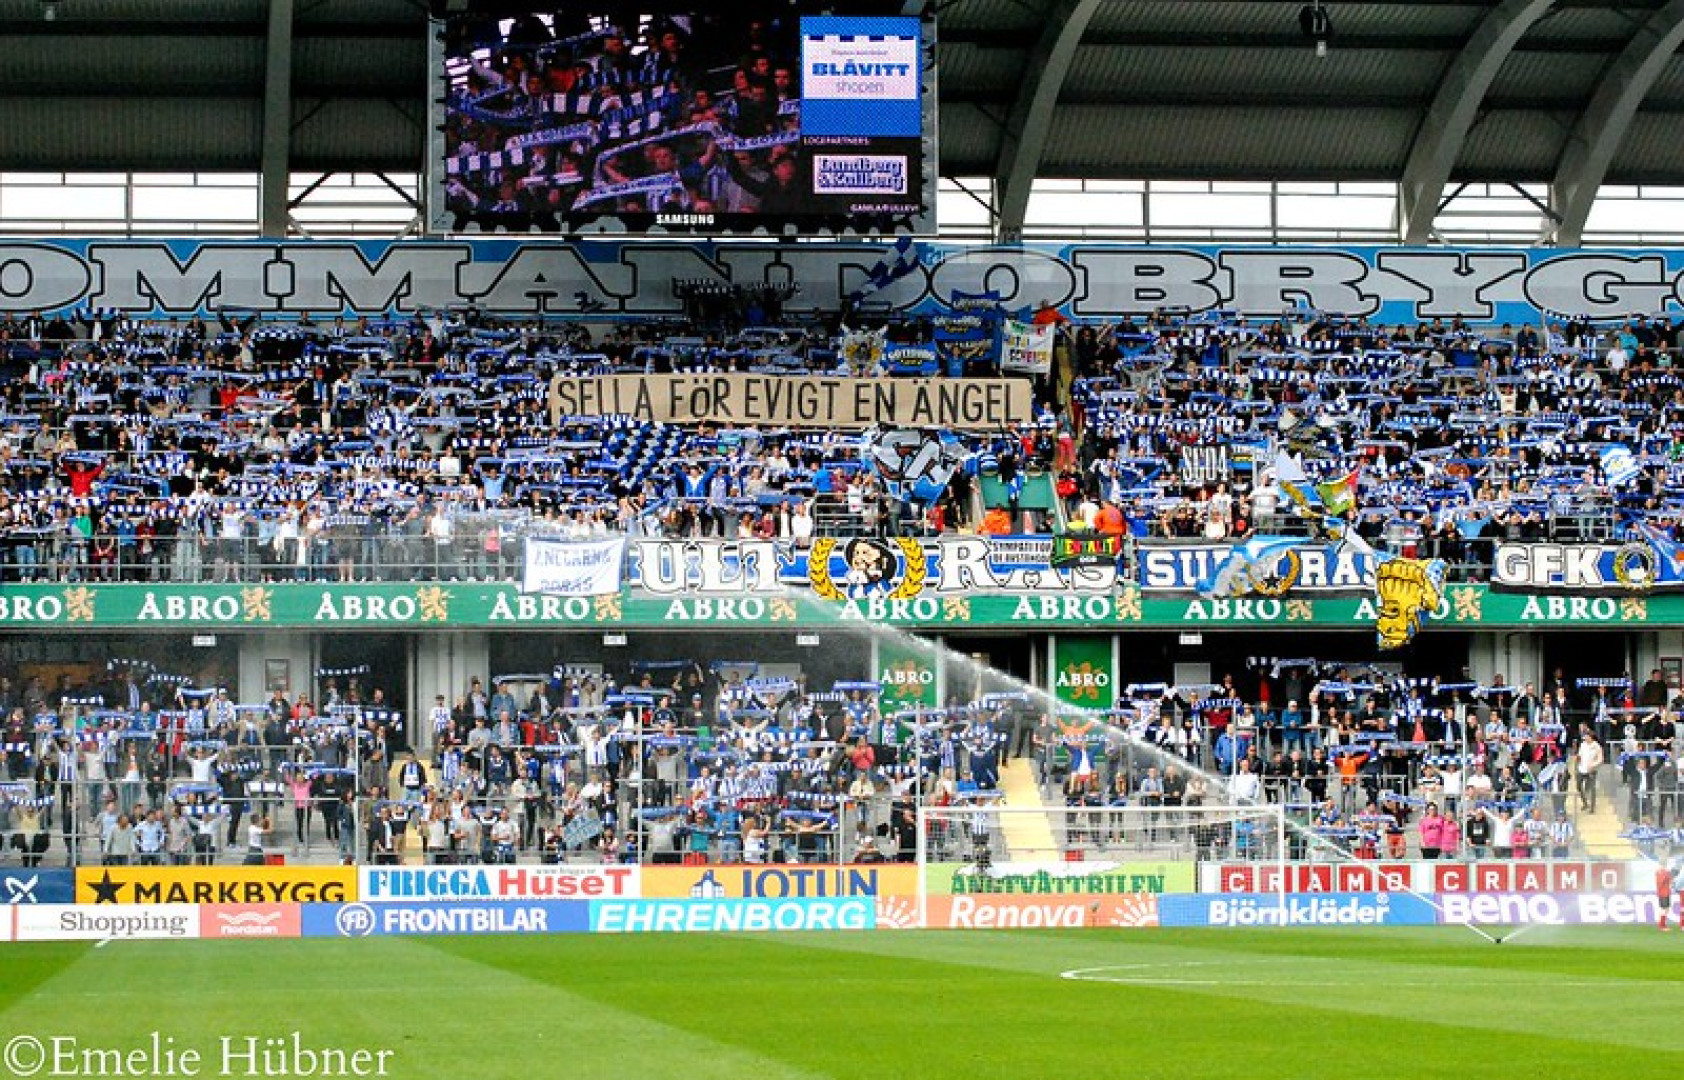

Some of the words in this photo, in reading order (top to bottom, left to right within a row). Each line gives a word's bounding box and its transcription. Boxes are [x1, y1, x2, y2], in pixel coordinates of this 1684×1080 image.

[812, 59, 910, 77] BLÅVITT
[656, 214, 715, 225] SAMSUNG
[557, 378, 653, 421] SELLA
[744, 379, 841, 420] EVIGT
[854, 382, 896, 422] EN
[910, 379, 1023, 423] ÄNGEL
[1498, 546, 1602, 587] GFK
[137, 592, 239, 621] ÅBRO
[314, 592, 416, 621] ÅBRO
[489, 592, 591, 621] ÅBRO
[134, 881, 345, 902] MARKBYGG
[368, 870, 491, 896] FRIGGA
[499, 868, 632, 896] HuseT
[1228, 872, 1402, 891] CRAMO
[1443, 870, 1618, 890] CRAMO
[384, 908, 548, 932] FRONTBILAR
[596, 903, 868, 931] EHRENBORG
[951, 896, 1086, 928] Renova
[1209, 898, 1390, 925] Björnkläder
[1442, 893, 1564, 924] BenQ
[60, 911, 188, 936] Shopping
